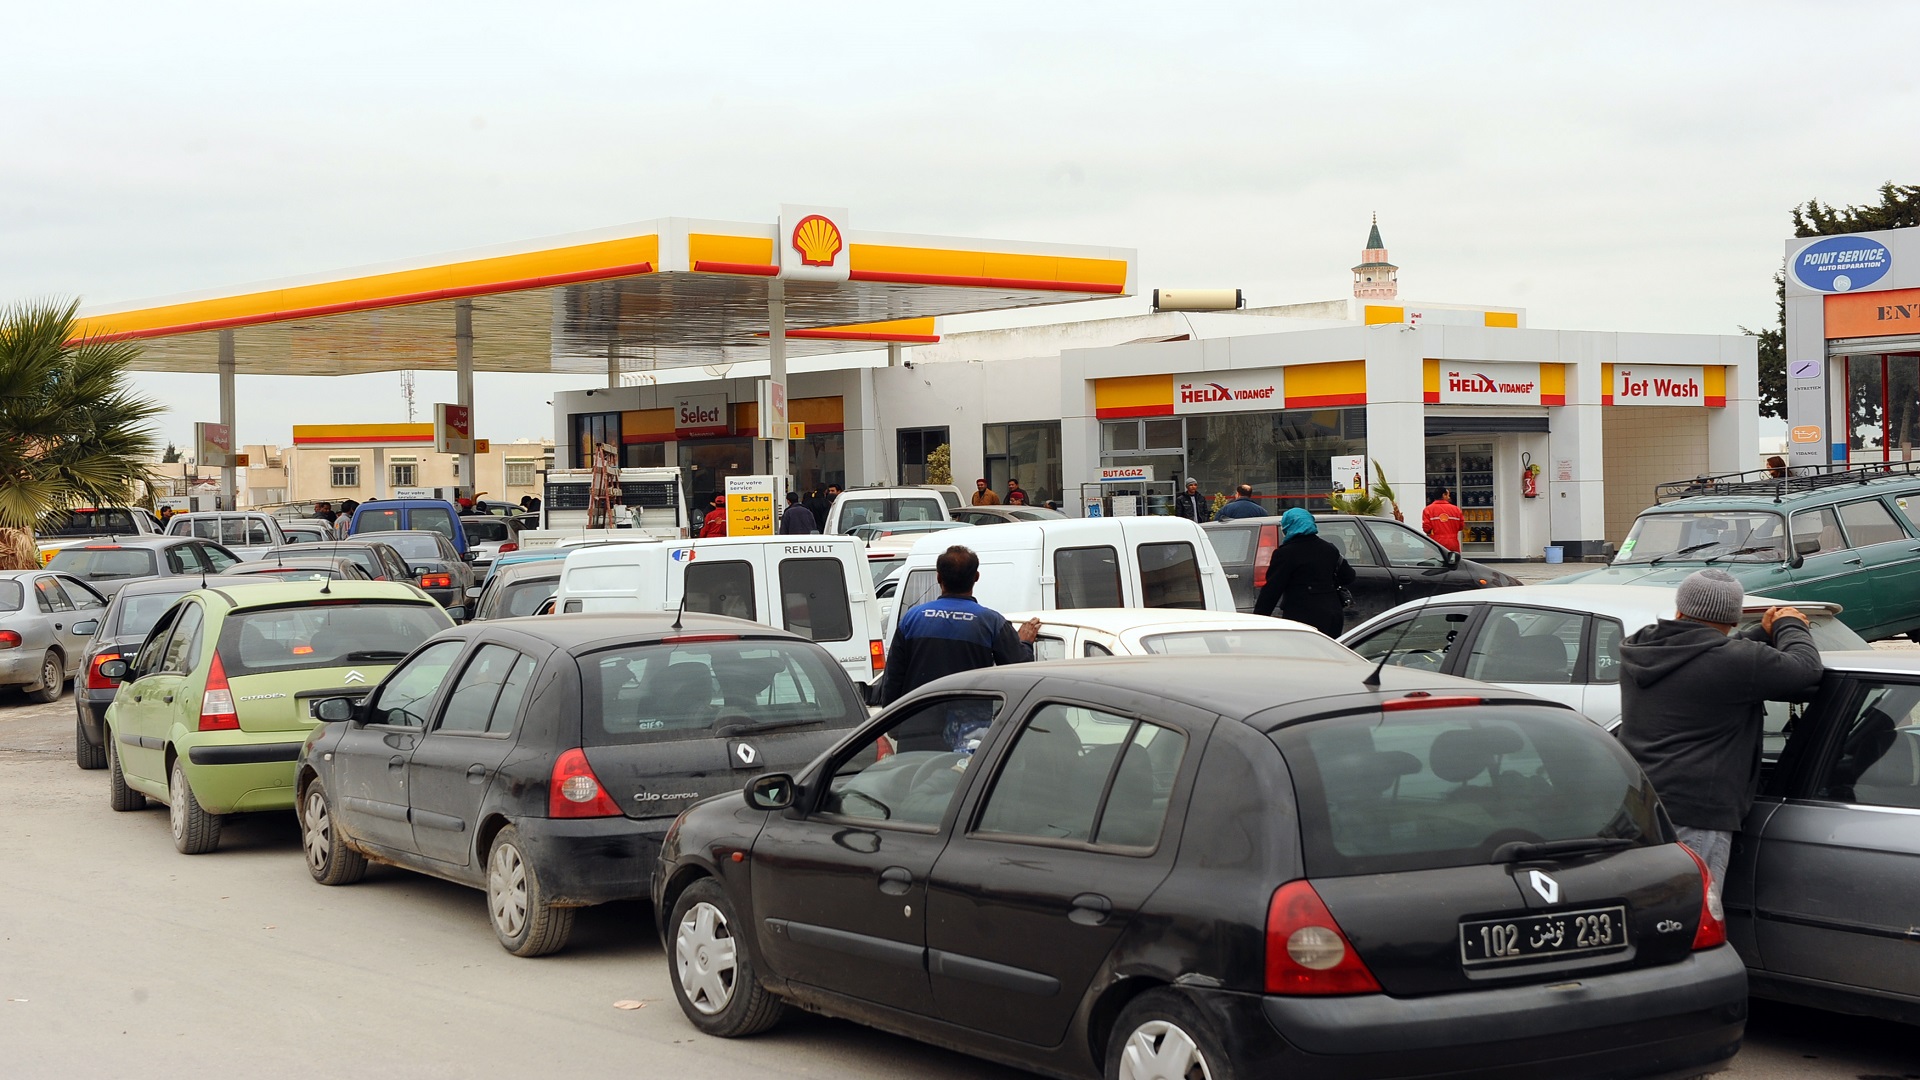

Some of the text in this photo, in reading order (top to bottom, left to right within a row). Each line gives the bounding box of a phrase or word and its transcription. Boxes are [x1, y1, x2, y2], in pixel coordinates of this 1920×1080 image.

[1803, 248, 1885, 266] POINT SERVICE
[1818, 261, 1881, 272] AUTO REPARATION
[1449, 374, 1498, 393] HELIX
[1621, 377, 1699, 398] Jet Wash
[1181, 384, 1234, 404] HELIX
[680, 405, 720, 425] Select
[794, 426, 799, 436] 1
[480, 442, 486, 450] 3
[1103, 469, 1143, 478] BUTAGAZ
[741, 495, 769, 503] Extra
[681, 551, 689, 559] F
[784, 544, 834, 555] RENAULT
[923, 608, 976, 621] DAYCO
[1480, 912, 1613, 958] 102 تونس 233
